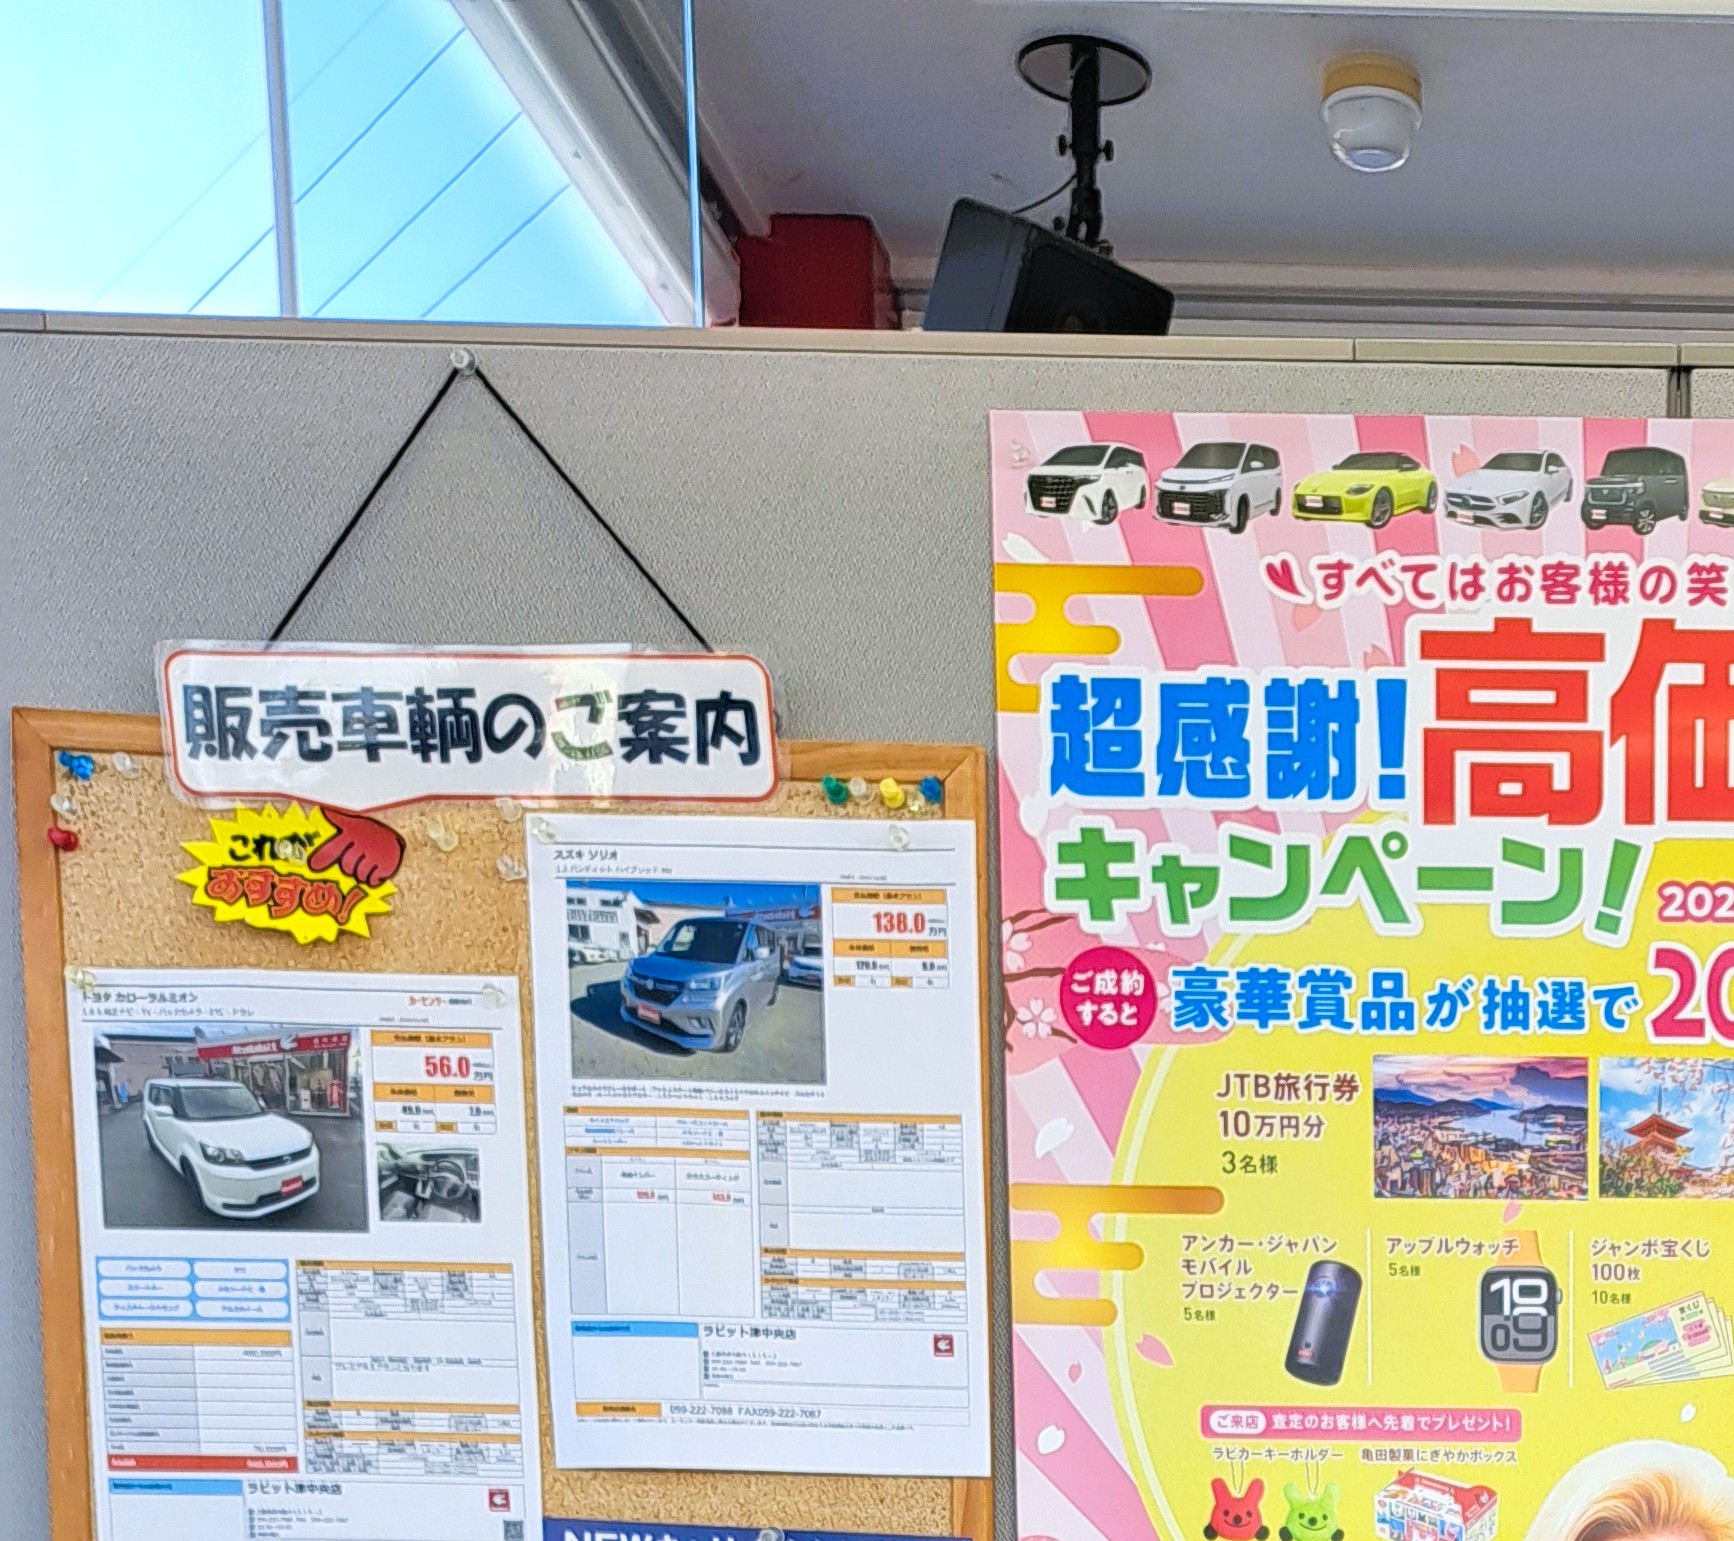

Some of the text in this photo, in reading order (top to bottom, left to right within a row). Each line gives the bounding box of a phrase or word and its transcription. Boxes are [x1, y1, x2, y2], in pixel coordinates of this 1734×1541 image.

[184, 684, 762, 768] 販売車輌のご案内
[1056, 828, 1642, 935] キャンペーン!
[873, 912, 925, 934] 138.0
[425, 1055, 470, 1078] 56.0
[1216, 1073, 1360, 1102] JTB旅行券
[1219, 1112, 1325, 1140] 10万円分
[1222, 1152, 1278, 1174] 3名様
[1387, 1238, 1519, 1255] アップルウォッチ
[1591, 1238, 1710, 1259] ジャンボ宝くじ
[1182, 1259, 1252, 1276] モバイル
[1592, 1262, 1641, 1282] 100枚
[1182, 1283, 1299, 1300] プロジェクター
